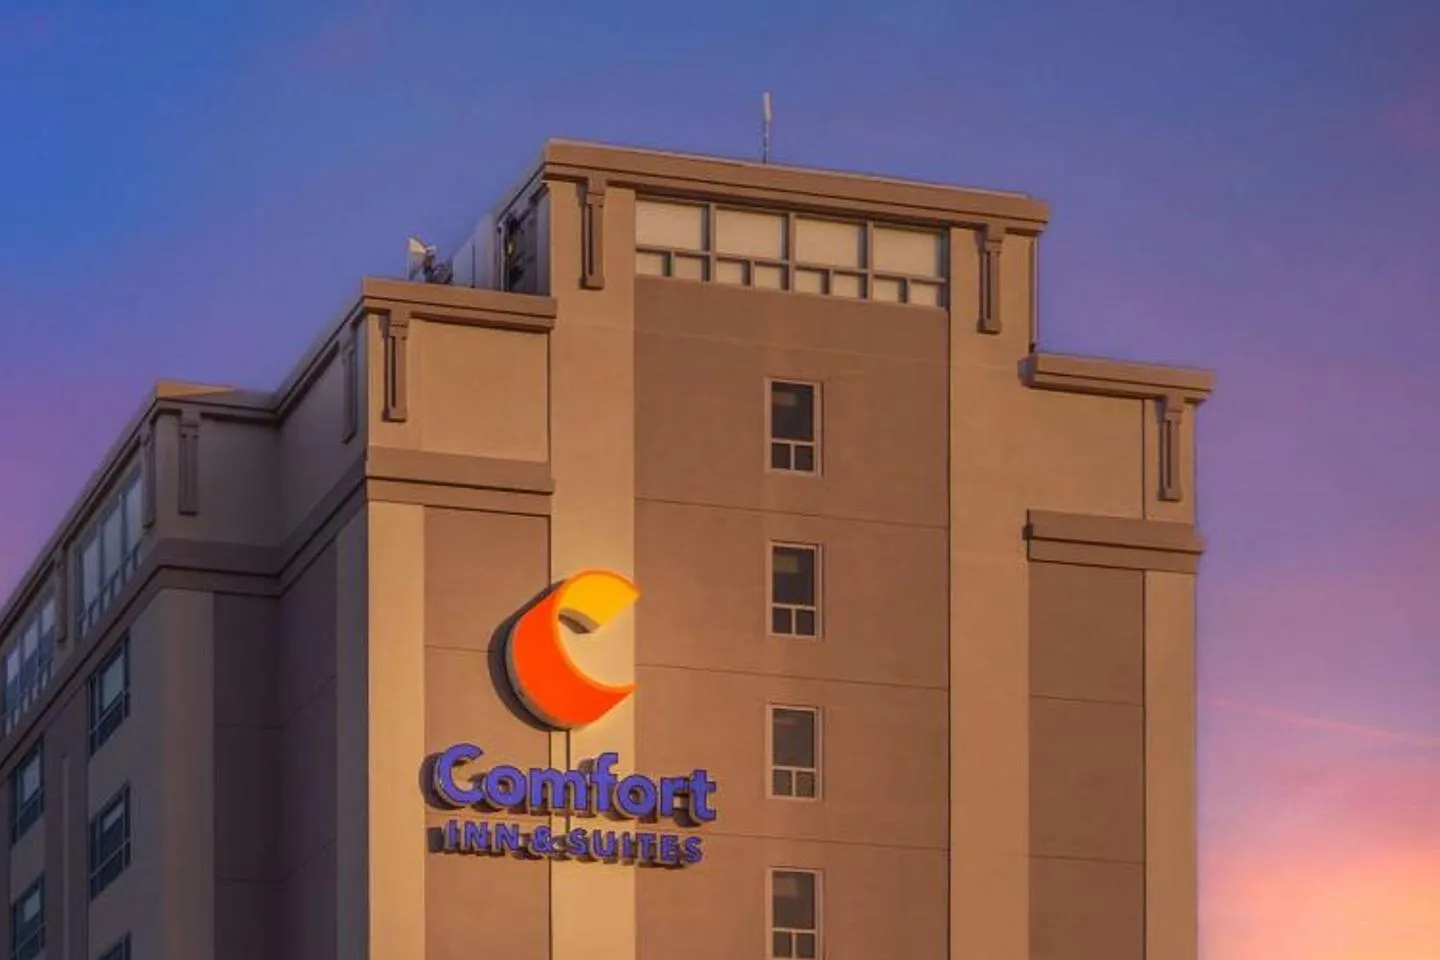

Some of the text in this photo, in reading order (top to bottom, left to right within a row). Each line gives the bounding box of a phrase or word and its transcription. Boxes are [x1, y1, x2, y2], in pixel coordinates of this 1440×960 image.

[434, 743, 716, 822] Comfort
[444, 819, 703, 864] INN & SUITES
